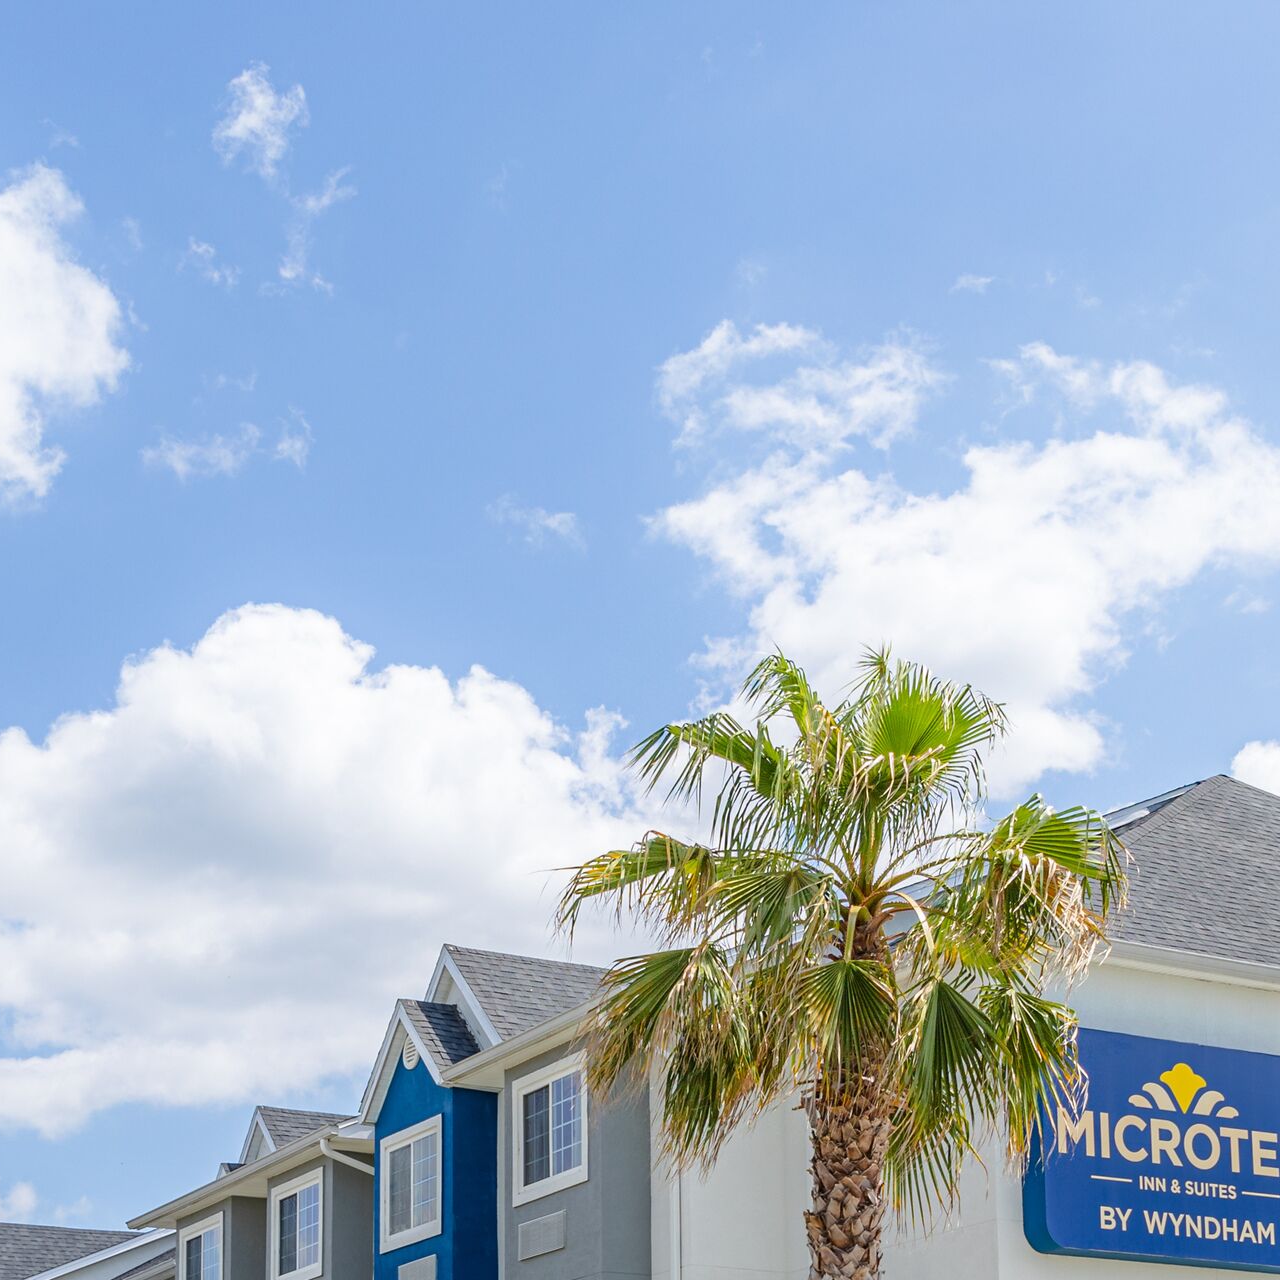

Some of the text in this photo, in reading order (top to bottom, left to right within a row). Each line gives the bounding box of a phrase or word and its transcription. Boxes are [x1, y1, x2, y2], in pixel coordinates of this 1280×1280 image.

[1139, 1176, 1237, 1200] INN & SUITES
[1099, 1205, 1276, 1246] BY WYNDHAM
